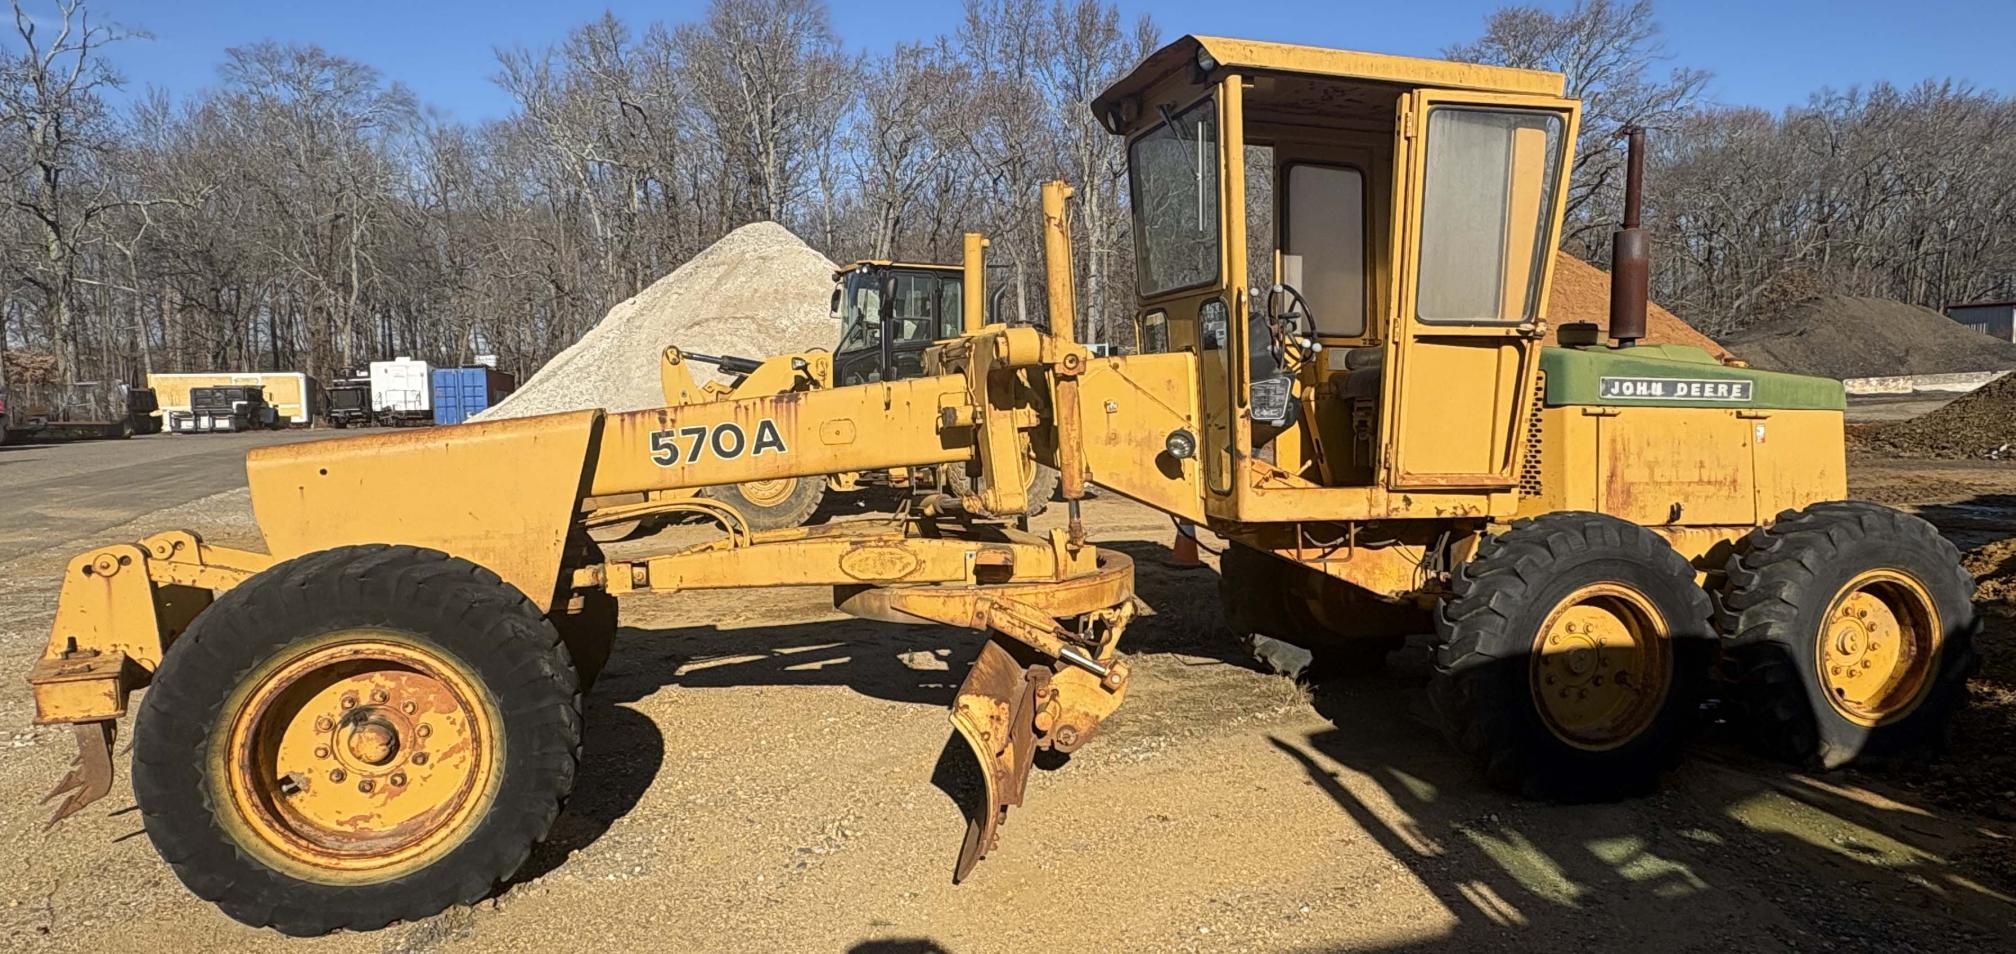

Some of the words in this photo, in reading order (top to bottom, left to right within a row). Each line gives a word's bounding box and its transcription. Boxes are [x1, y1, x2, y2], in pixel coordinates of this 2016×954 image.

[1610, 381, 1664, 396] JOHN
[1675, 383, 1742, 398] DEERE
[650, 418, 788, 468] 570A
